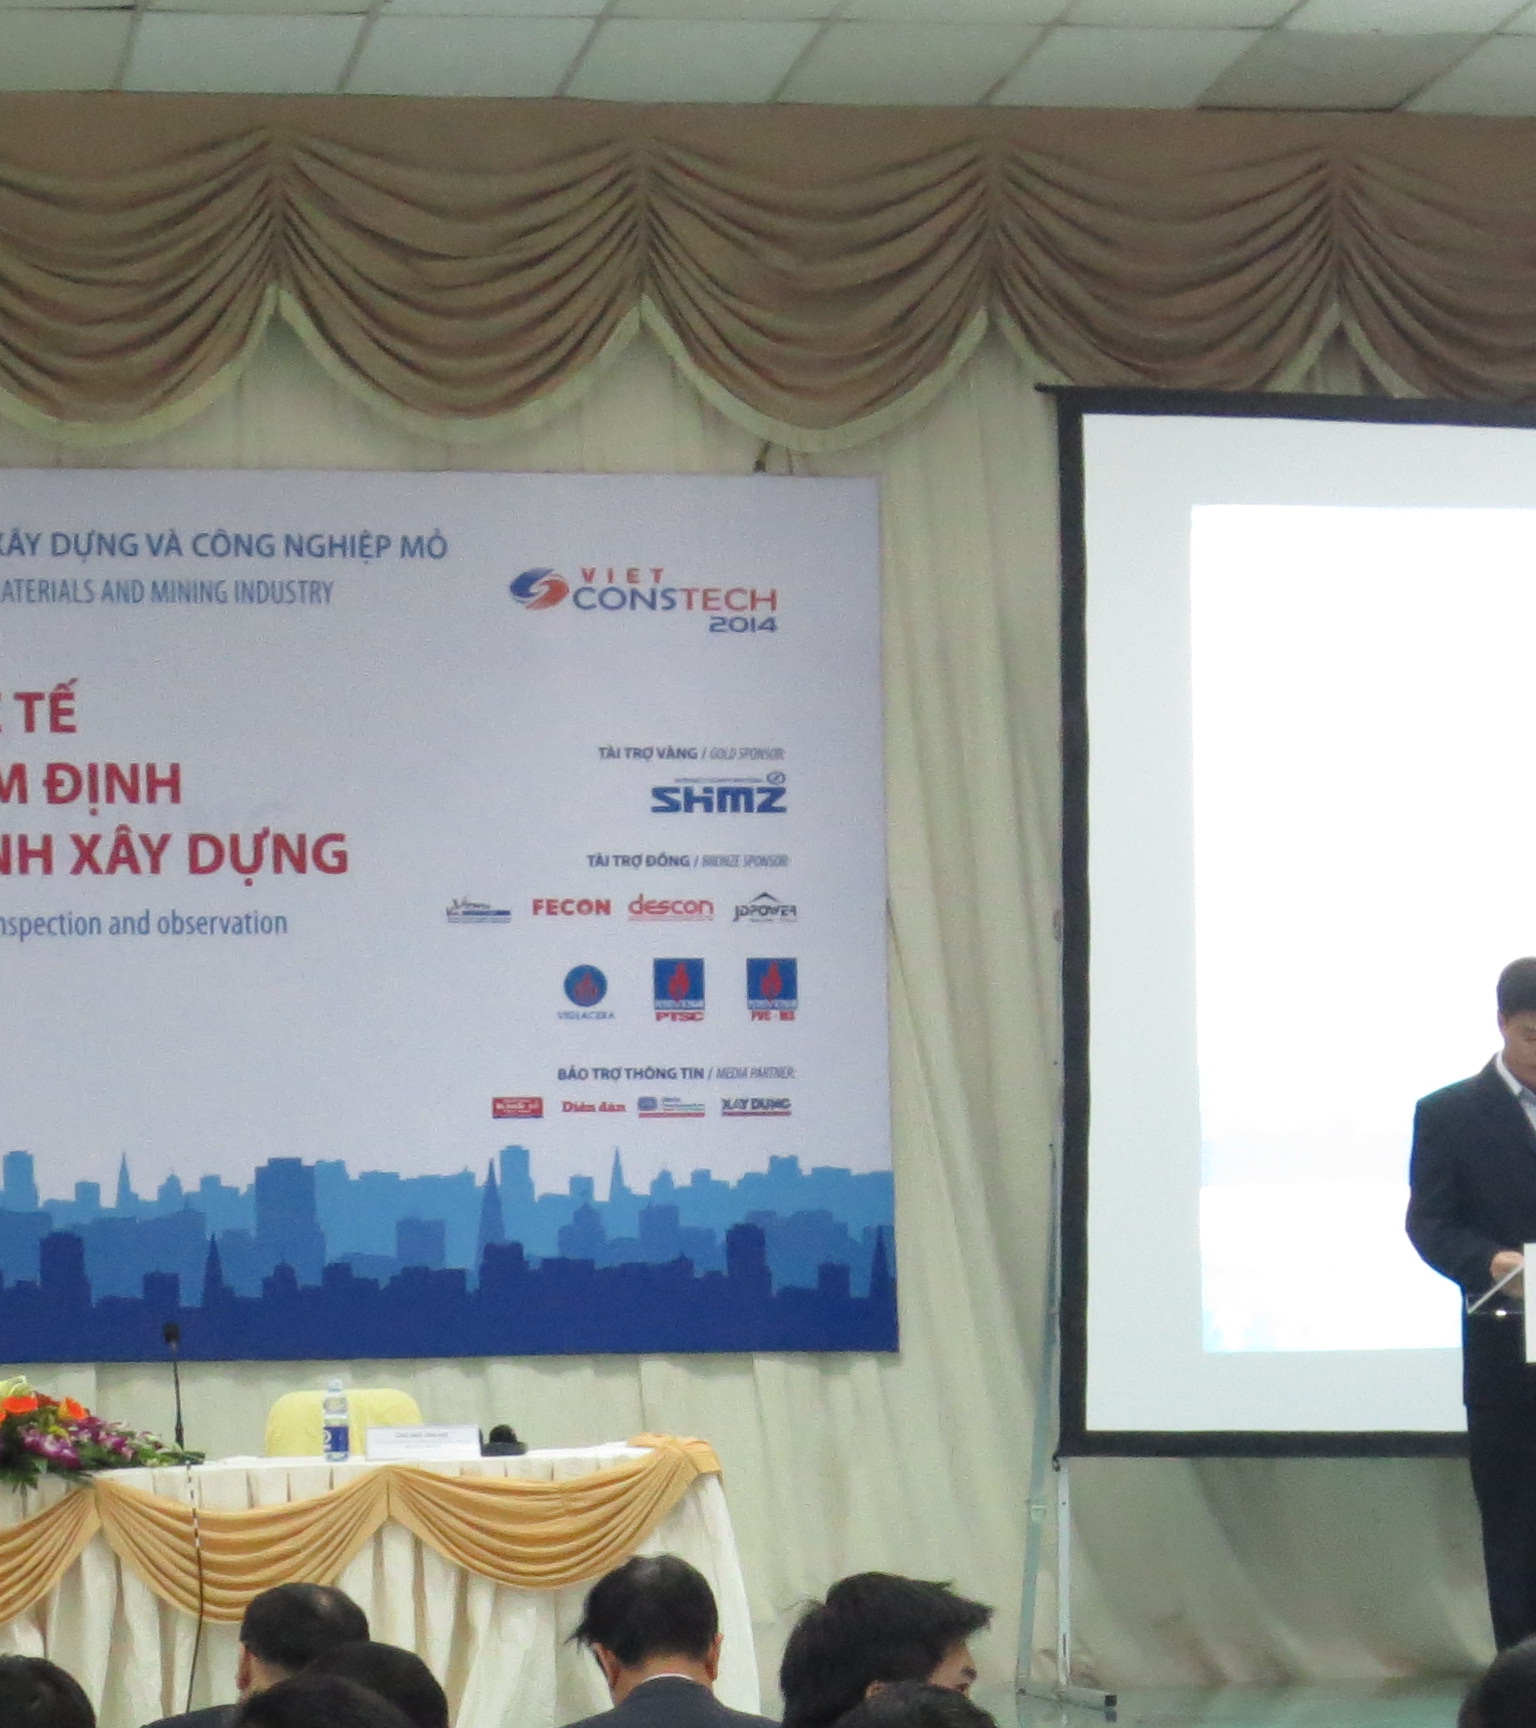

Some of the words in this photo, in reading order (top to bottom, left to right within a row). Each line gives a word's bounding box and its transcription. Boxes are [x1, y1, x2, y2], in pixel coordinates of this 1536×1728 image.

[51, 529, 139, 563] DỰNG
[146, 527, 185, 558] VÀ
[192, 528, 276, 559] CÔNG
[283, 528, 392, 565] NGHIỆP
[400, 526, 449, 560] MỎ
[580, 567, 664, 584] VIET
[100, 579, 145, 605] AND
[150, 579, 229, 605] MINING
[233, 579, 335, 606] INDUSTRY
[572, 586, 778, 611] CONSTECH
[708, 616, 778, 633] 2014
[13, 677, 79, 734] TẾ
[42, 762, 182, 818] ĐỊNH
[68, 823, 172, 875] XÂY
[188, 826, 349, 887] DỰNG
[531, 898, 613, 916] FECON
[627, 892, 715, 916] descon
[109, 908, 151, 936] and
[156, 909, 289, 936] observation
